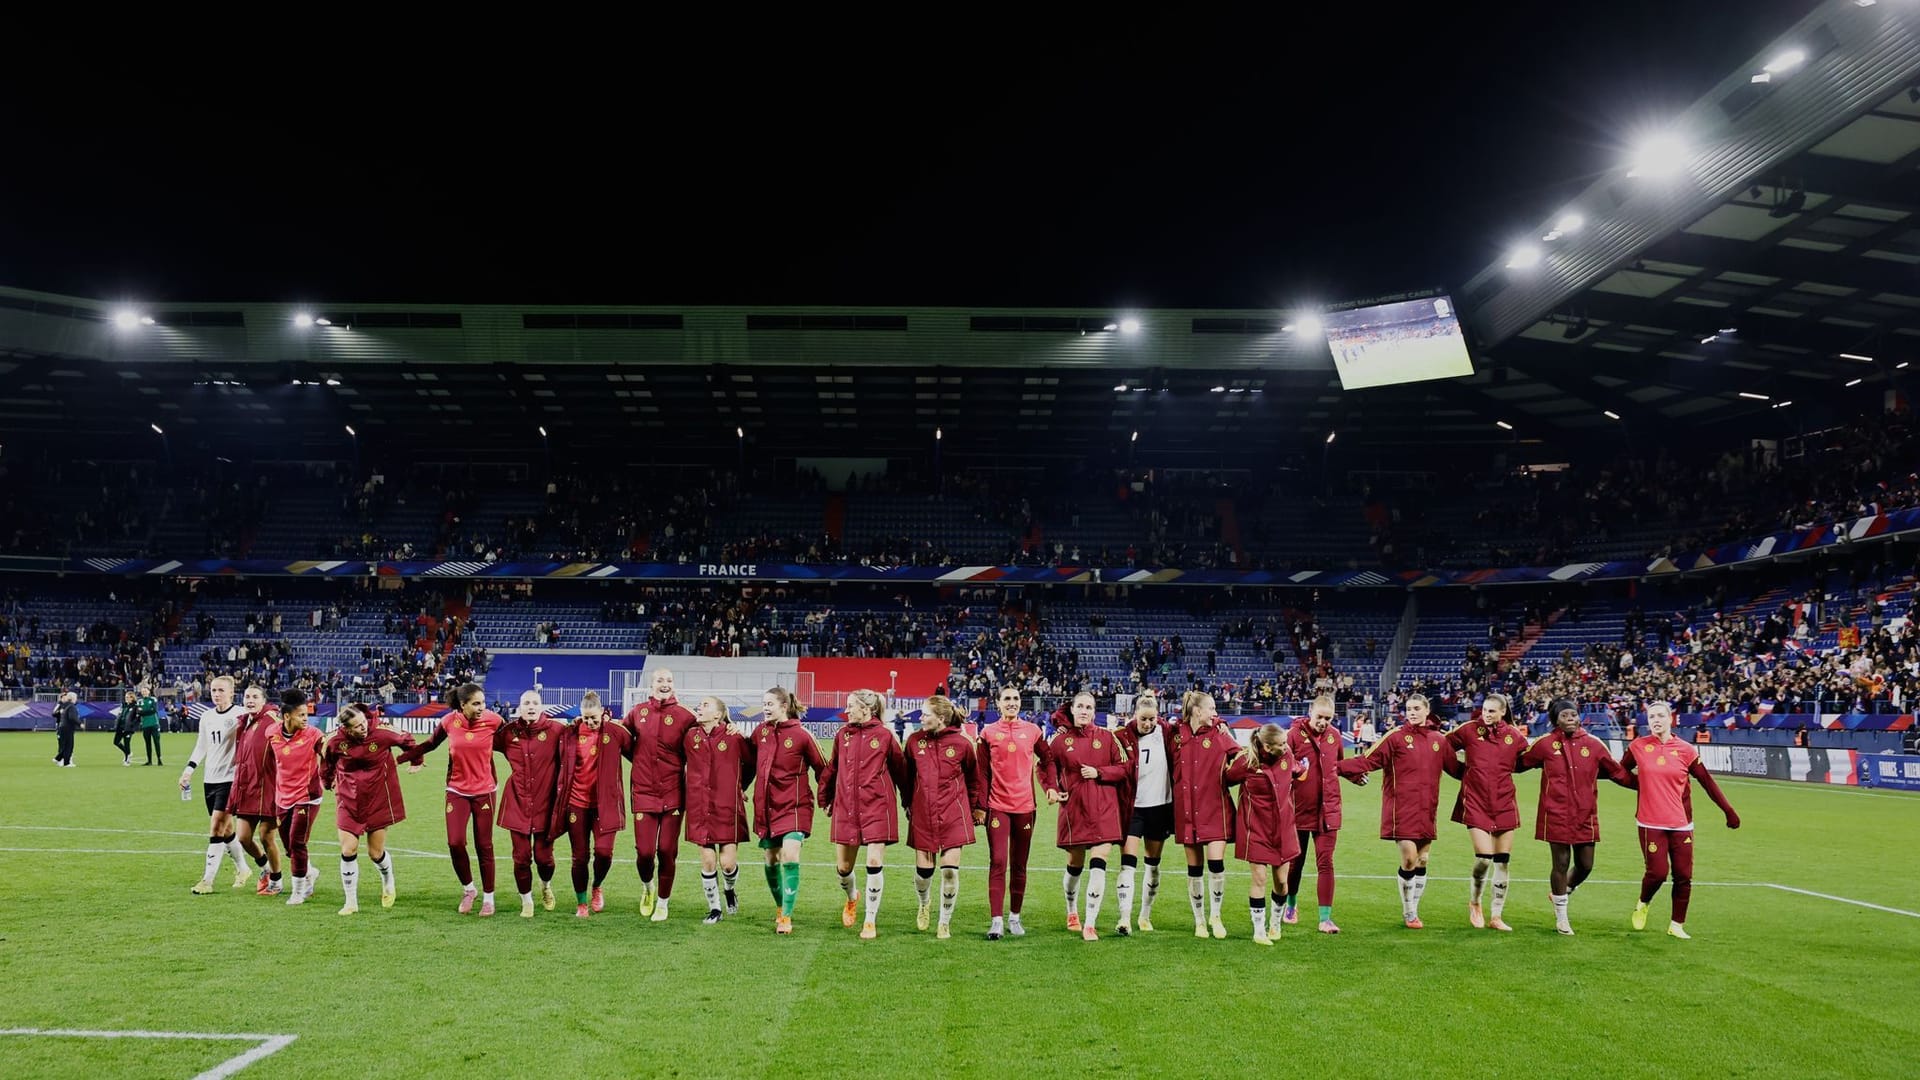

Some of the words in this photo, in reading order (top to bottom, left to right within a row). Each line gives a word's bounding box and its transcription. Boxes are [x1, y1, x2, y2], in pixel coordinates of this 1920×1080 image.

[699, 564, 756, 576] FRANCE
[211, 730, 221, 744] 11
[1141, 748, 1150, 764] 7
